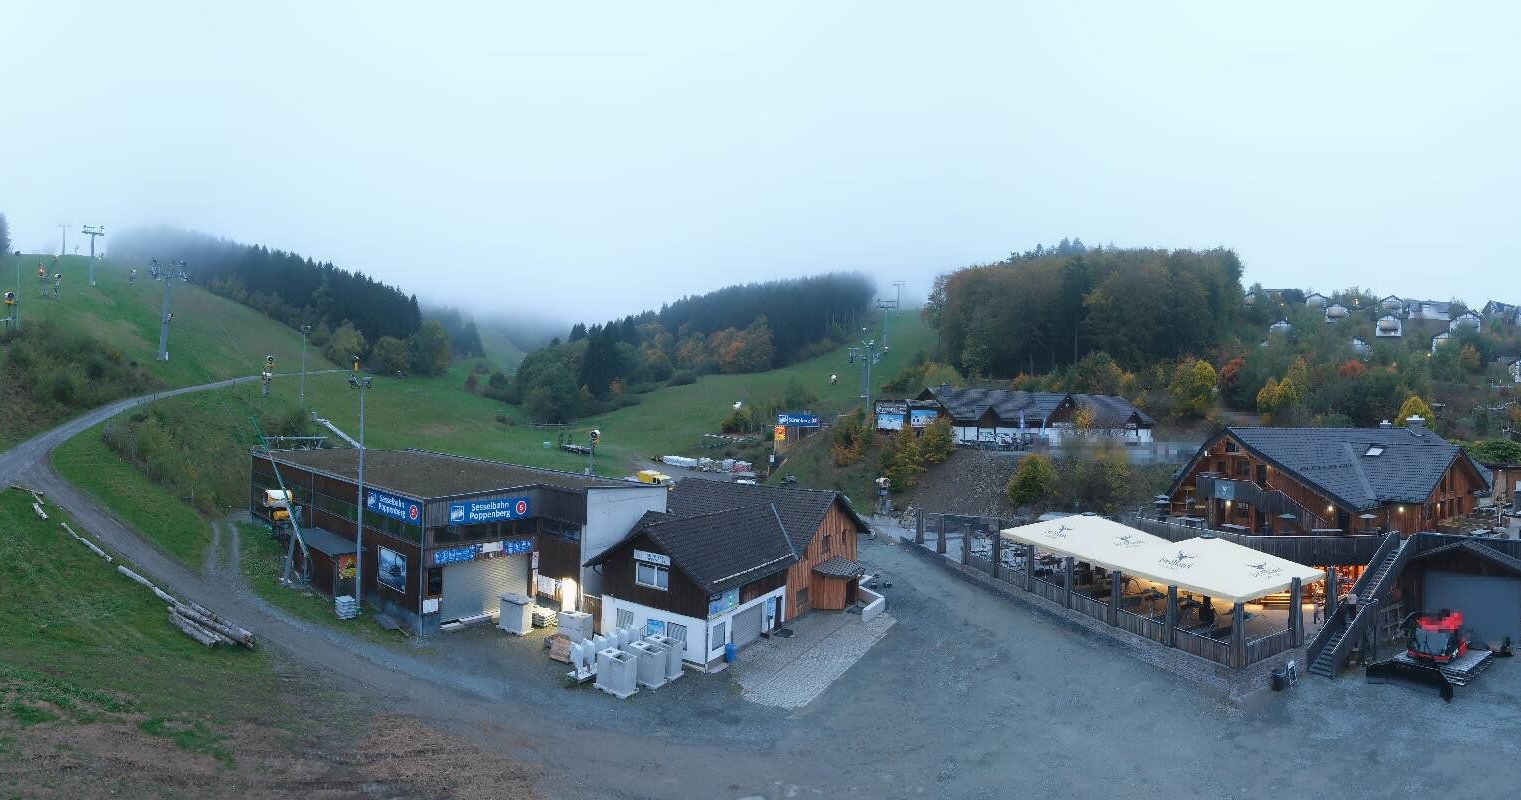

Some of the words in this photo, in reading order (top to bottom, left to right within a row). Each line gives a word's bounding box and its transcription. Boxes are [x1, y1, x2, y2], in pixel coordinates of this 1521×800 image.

[380, 495, 405, 508] Sesselbahn
[471, 501, 510, 512] Sesselbahn
[379, 503, 406, 518] Poppenberg
[518, 504, 524, 512] 5
[469, 509, 511, 521] Poppenberg
